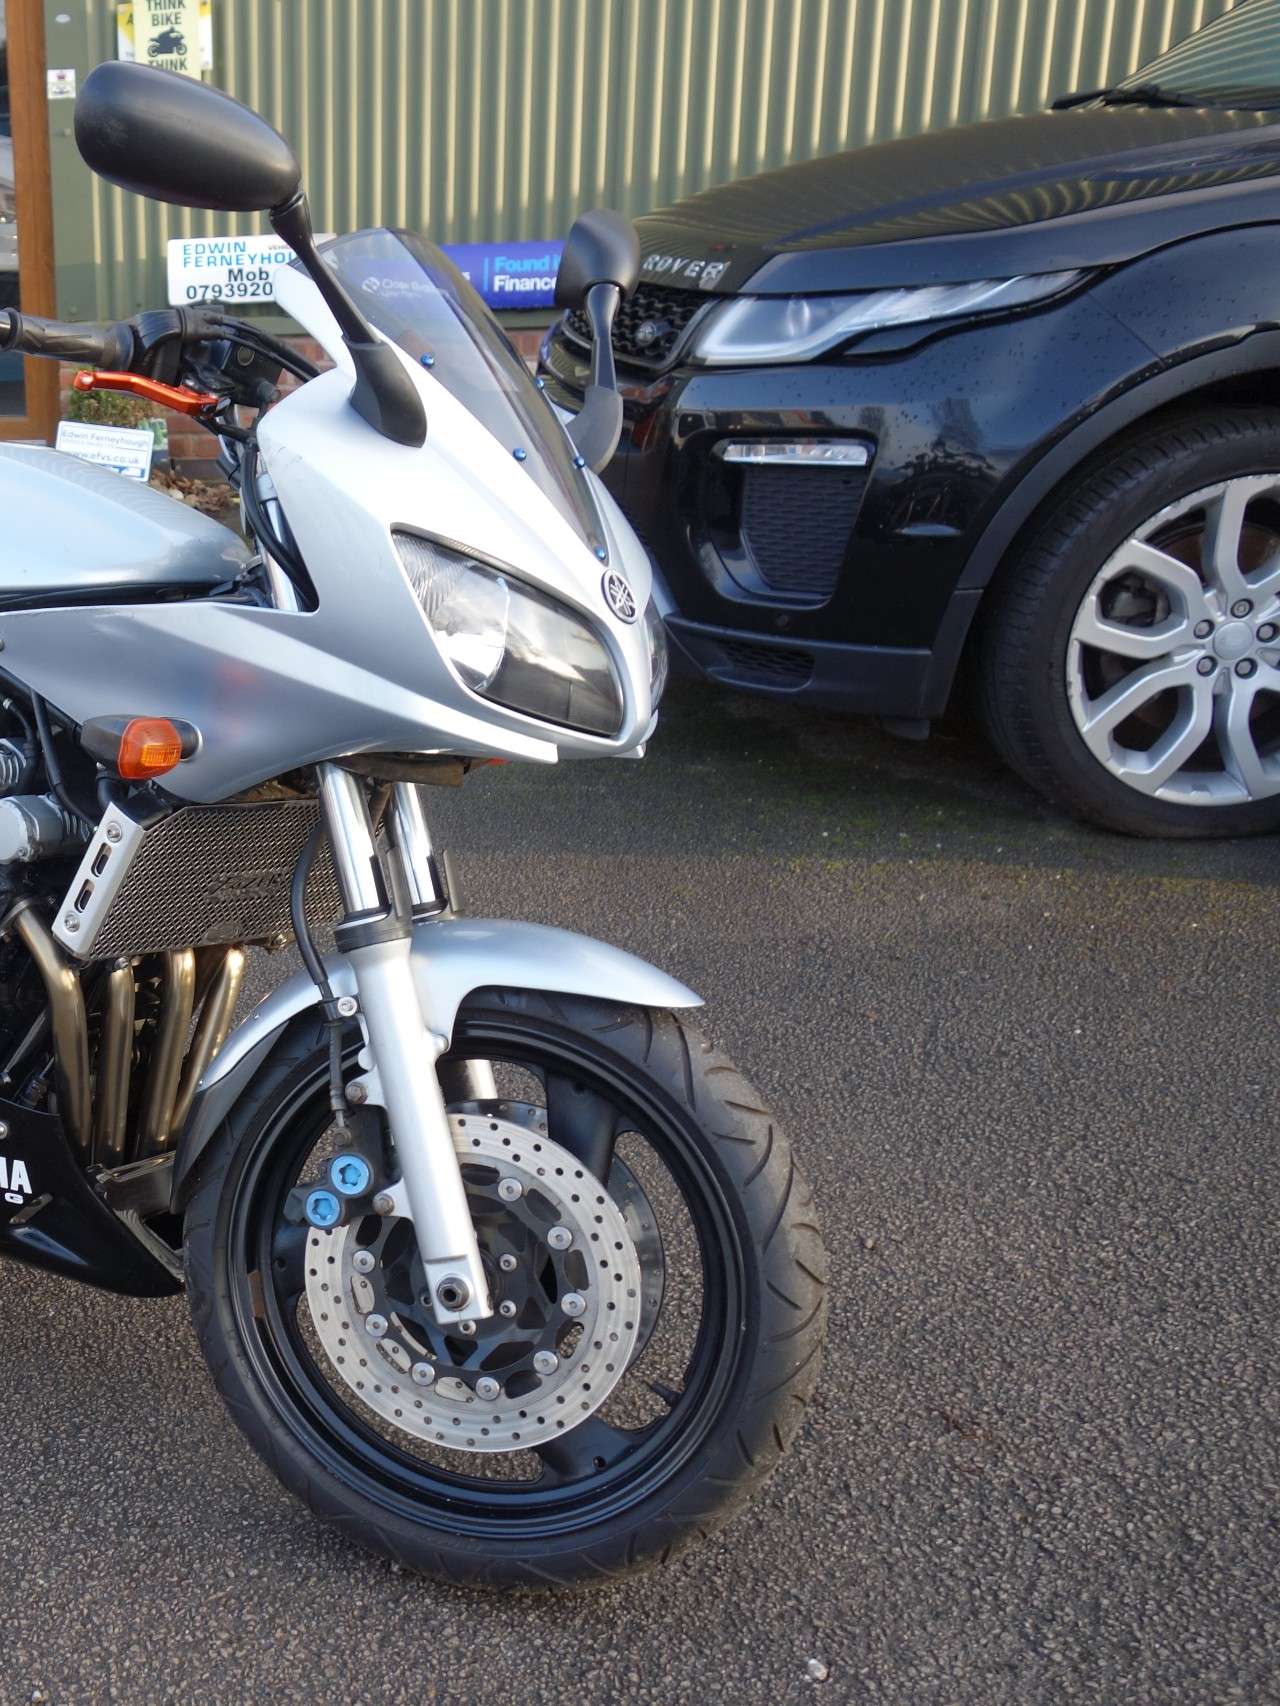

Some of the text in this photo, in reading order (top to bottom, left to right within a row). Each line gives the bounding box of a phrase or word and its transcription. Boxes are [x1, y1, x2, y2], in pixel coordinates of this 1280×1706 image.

[146, 0, 186, 11] THINK
[151, 12, 182, 26] BIKE
[183, 241, 247, 256] EDWIN
[494, 256, 550, 272] Found
[642, 254, 724, 279] ROVER
[228, 267, 269, 283] Mob
